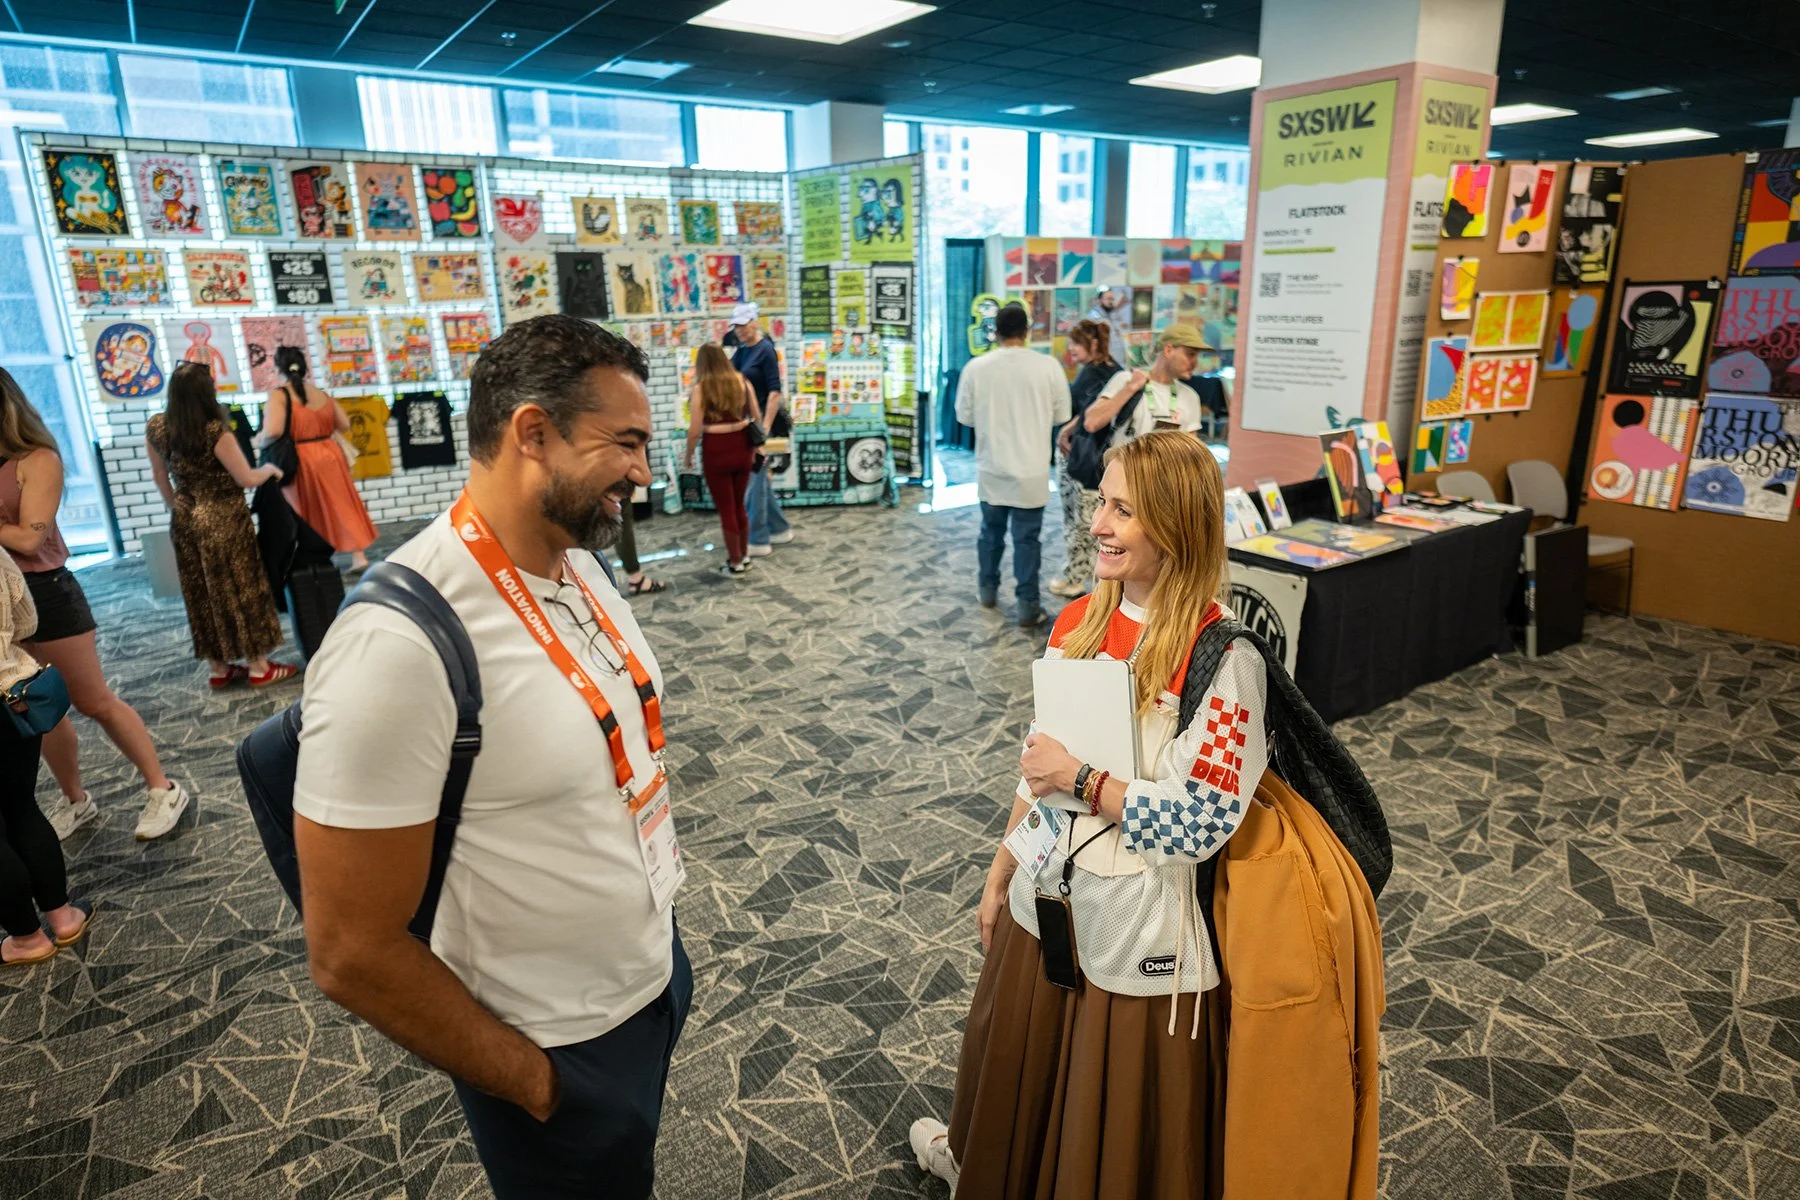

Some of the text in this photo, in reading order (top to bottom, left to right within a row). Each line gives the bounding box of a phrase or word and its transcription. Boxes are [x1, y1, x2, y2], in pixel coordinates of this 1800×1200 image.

[1278, 103, 1350, 140] SXSW
[1425, 98, 1470, 128] SXSW
[1283, 146, 1364, 168] RIVIAN
[1426, 140, 1472, 157] RIVIAN
[282, 260, 314, 275] $25
[351, 256, 396, 270] RECORDS
[287, 289, 320, 304] $60
[1705, 406, 1786, 433] THU
[1700, 428, 1800, 453] RSTON
[1691, 444, 1799, 472] MOORE
[494, 568, 554, 645] INNOVATION
[1145, 961, 1175, 972] Deus
